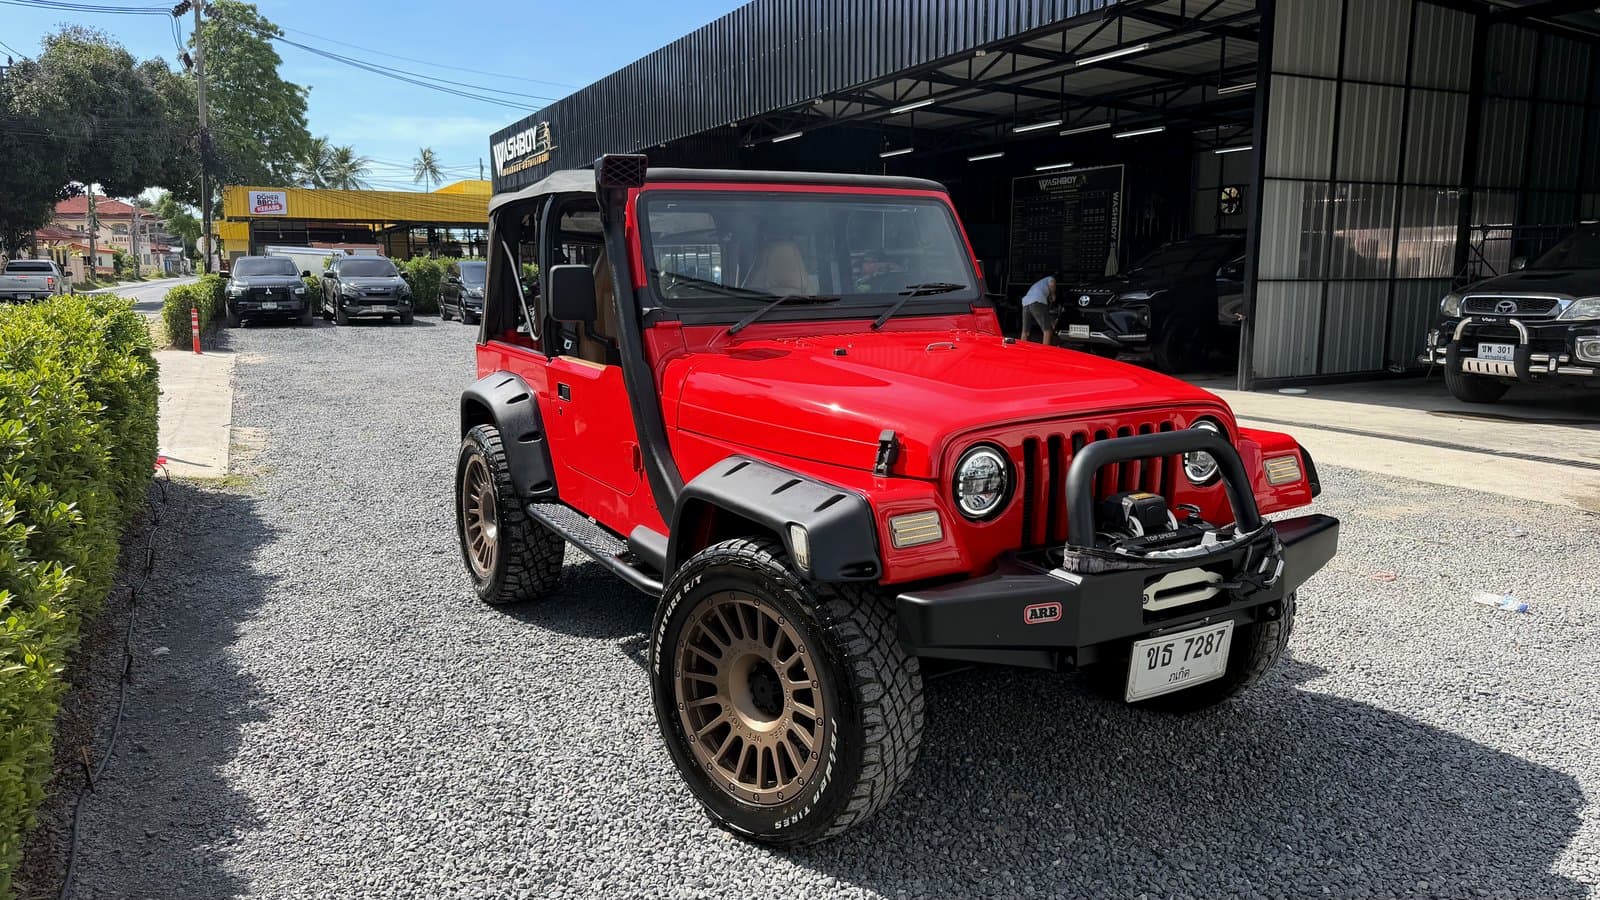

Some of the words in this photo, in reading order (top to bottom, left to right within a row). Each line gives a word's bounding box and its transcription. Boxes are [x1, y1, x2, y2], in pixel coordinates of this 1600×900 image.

[493, 126, 537, 178] WASHBOY
[1497, 346, 1511, 354] 301
[1158, 531, 1177, 540] SPEED
[654, 592, 682, 675] ADVENTURE
[683, 575, 702, 593] R/T
[1029, 606, 1058, 620] ARB
[1147, 643, 1175, 670] ขธ
[1184, 629, 1226, 662] 7287
[775, 805, 811, 830] TIRES
